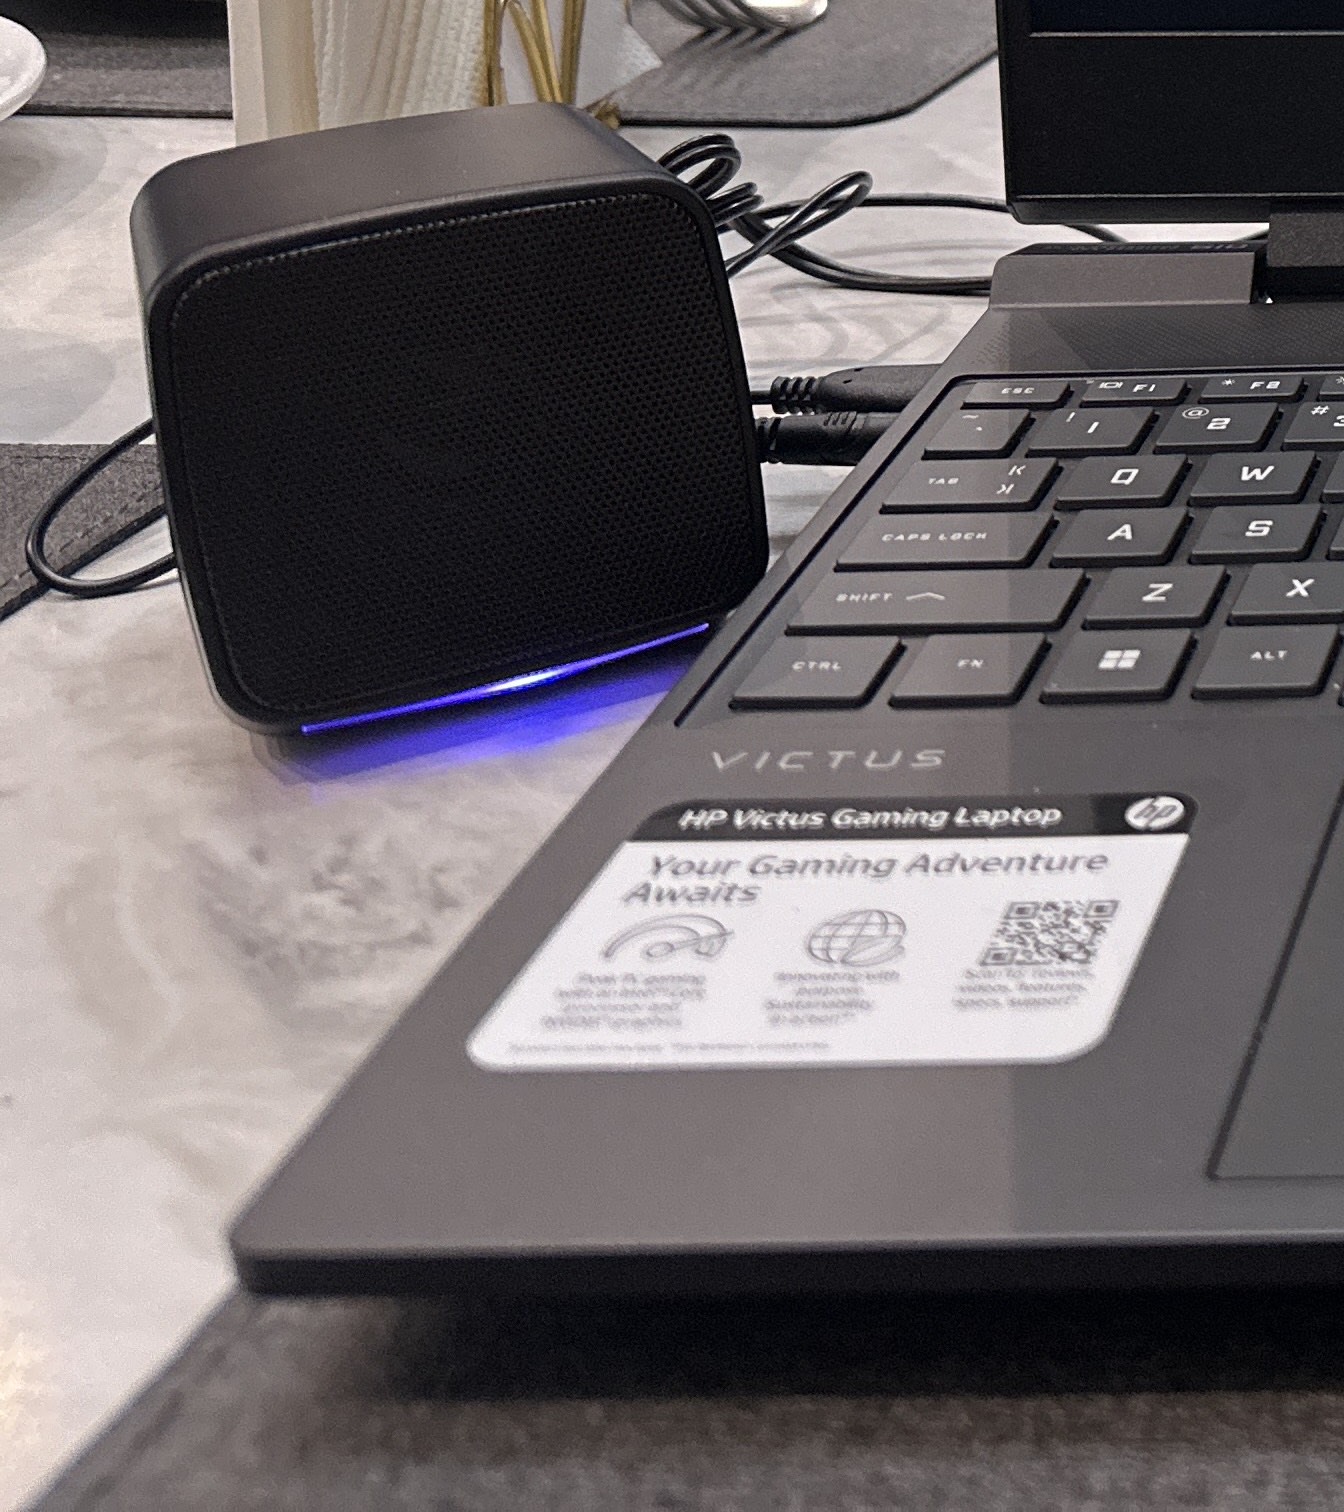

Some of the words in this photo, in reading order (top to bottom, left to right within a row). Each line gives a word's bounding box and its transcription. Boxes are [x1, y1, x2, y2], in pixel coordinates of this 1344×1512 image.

[1001, 387, 1035, 395] ESC
[1132, 383, 1156, 393] F1
[1249, 380, 1281, 390] F2
[1206, 417, 1231, 430] 2
[1110, 468, 1139, 486] Q
[1241, 465, 1275, 481] W
[1107, 523, 1133, 541] A
[1245, 520, 1274, 537] S
[1142, 583, 1173, 602] Z
[1285, 578, 1315, 597] X
[835, 592, 893, 603] SHIFT
[957, 659, 984, 668] FN
[1250, 650, 1287, 660] ALT
[712, 749, 946, 771] VICTUS
[679, 808, 727, 829] HP
[732, 807, 823, 829] Victus
[831, 806, 951, 830] Gaming
[955, 806, 1062, 830] Laptop
[650, 854, 740, 879] Your
[749, 853, 898, 879] Gaming
[905, 850, 1109, 875] Adventure
[623, 881, 761, 905] Awaits
